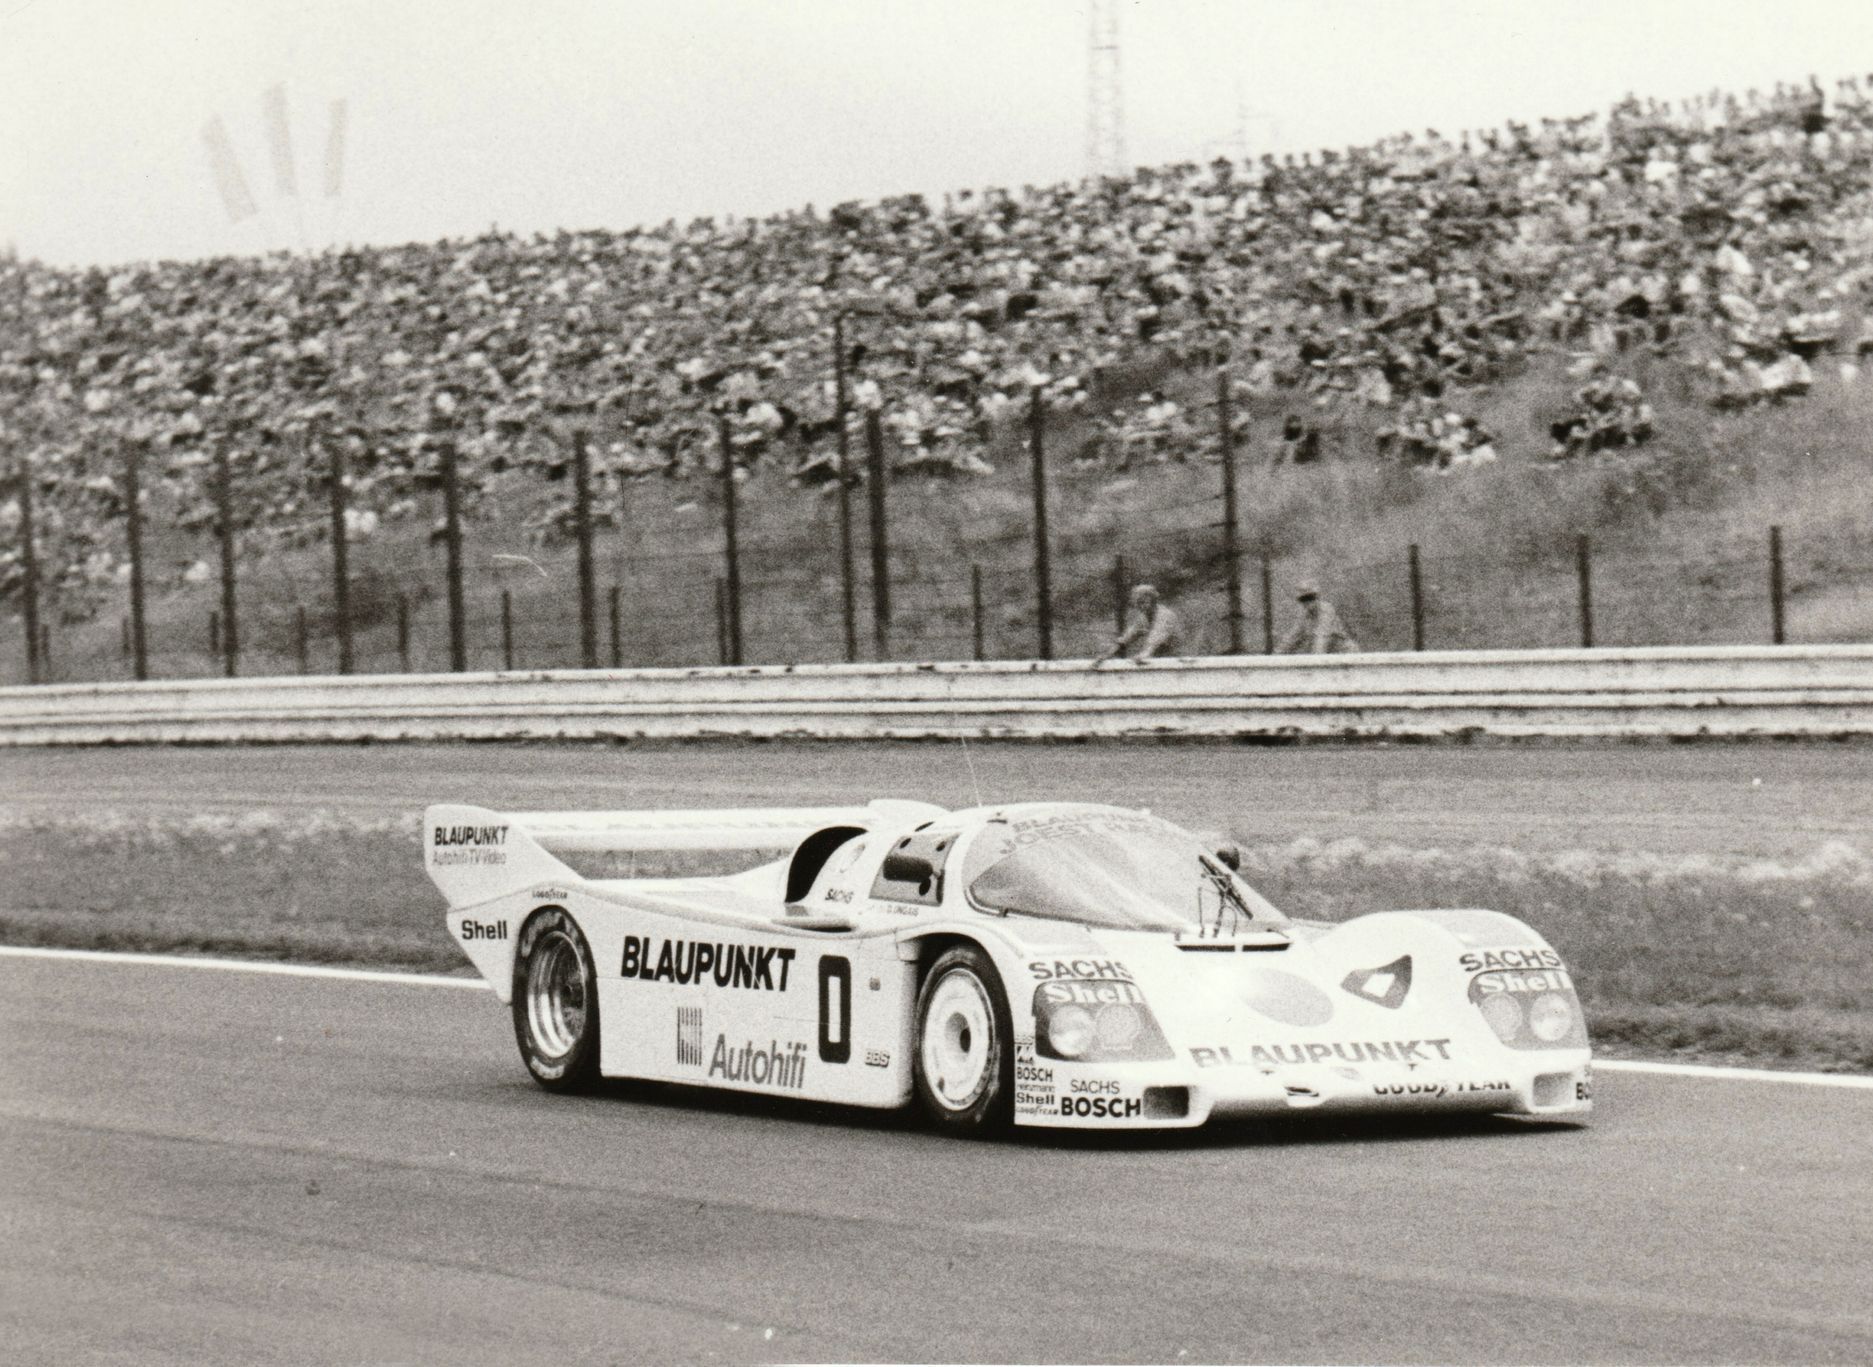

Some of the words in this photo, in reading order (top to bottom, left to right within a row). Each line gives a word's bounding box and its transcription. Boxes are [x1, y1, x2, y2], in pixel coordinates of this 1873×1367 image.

[434, 825, 509, 846] BLAUPUNKT
[461, 919, 508, 940] Shell
[620, 935, 796, 992] BLAUPUNKT
[1028, 959, 1134, 980] SACHS
[1459, 950, 1561, 972] SACHS
[1044, 982, 1147, 1004] Shell
[1476, 970, 1573, 994] Shell
[818, 954, 851, 1065] 0
[708, 1033, 807, 1089] Autohifi
[1189, 1038, 1451, 1068] BLAUPUNKT
[1016, 1066, 1053, 1082] BOSCH
[1016, 1091, 1055, 1105] Shell
[1071, 1080, 1120, 1095] SACHS
[1061, 1096, 1141, 1118] BOSCH
